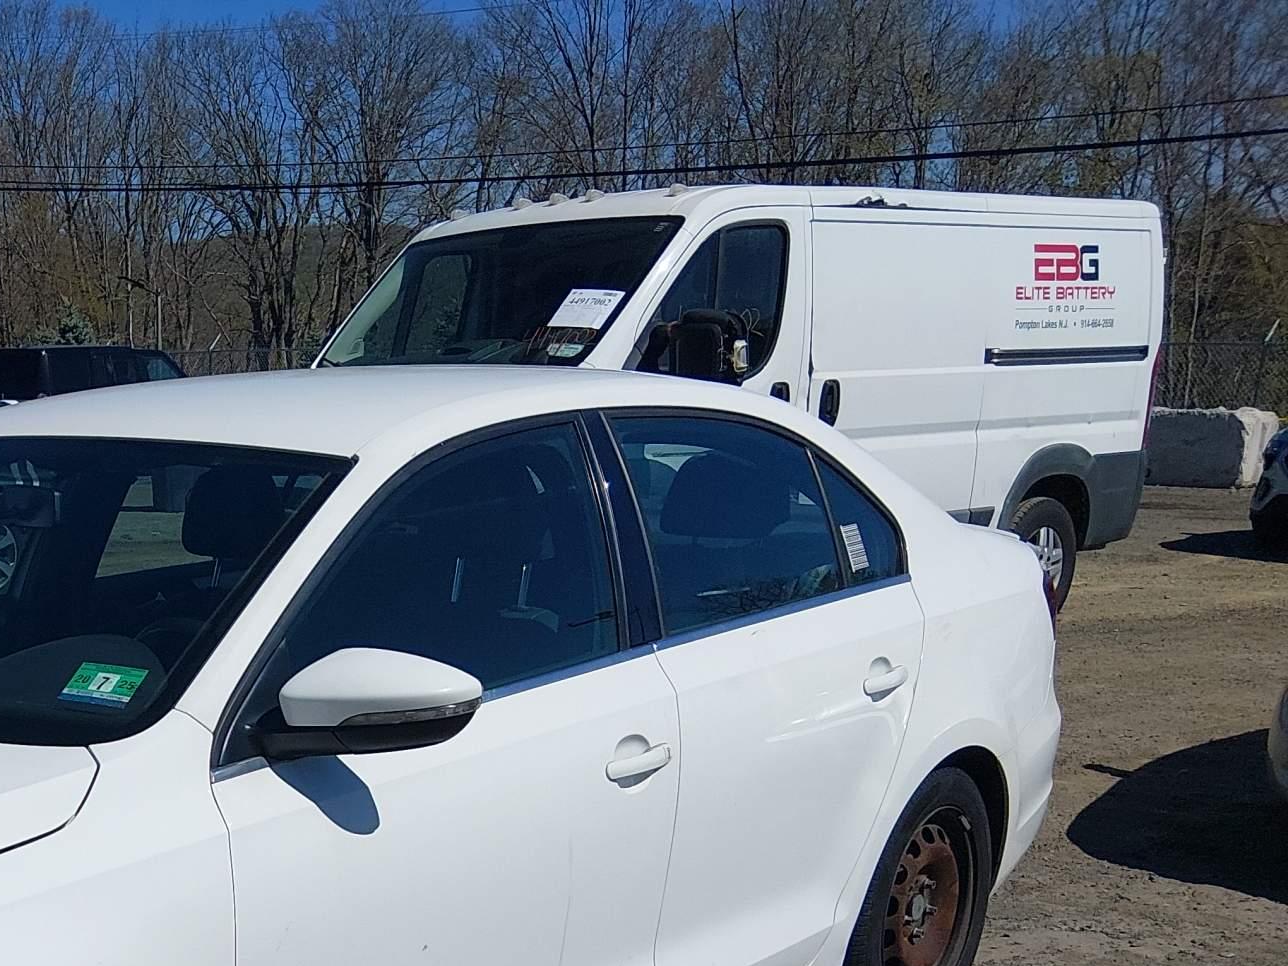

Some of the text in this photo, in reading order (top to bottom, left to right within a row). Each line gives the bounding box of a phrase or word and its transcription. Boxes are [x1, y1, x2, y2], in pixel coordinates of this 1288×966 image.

[1034, 244, 1099, 281] EBG
[1015, 286, 1116, 300] ELITE BATTERY
[1015, 319, 1040, 331] Pompton
[1041, 319, 1058, 329] Lakes
[74, 674, 137, 690] 20 7 25
